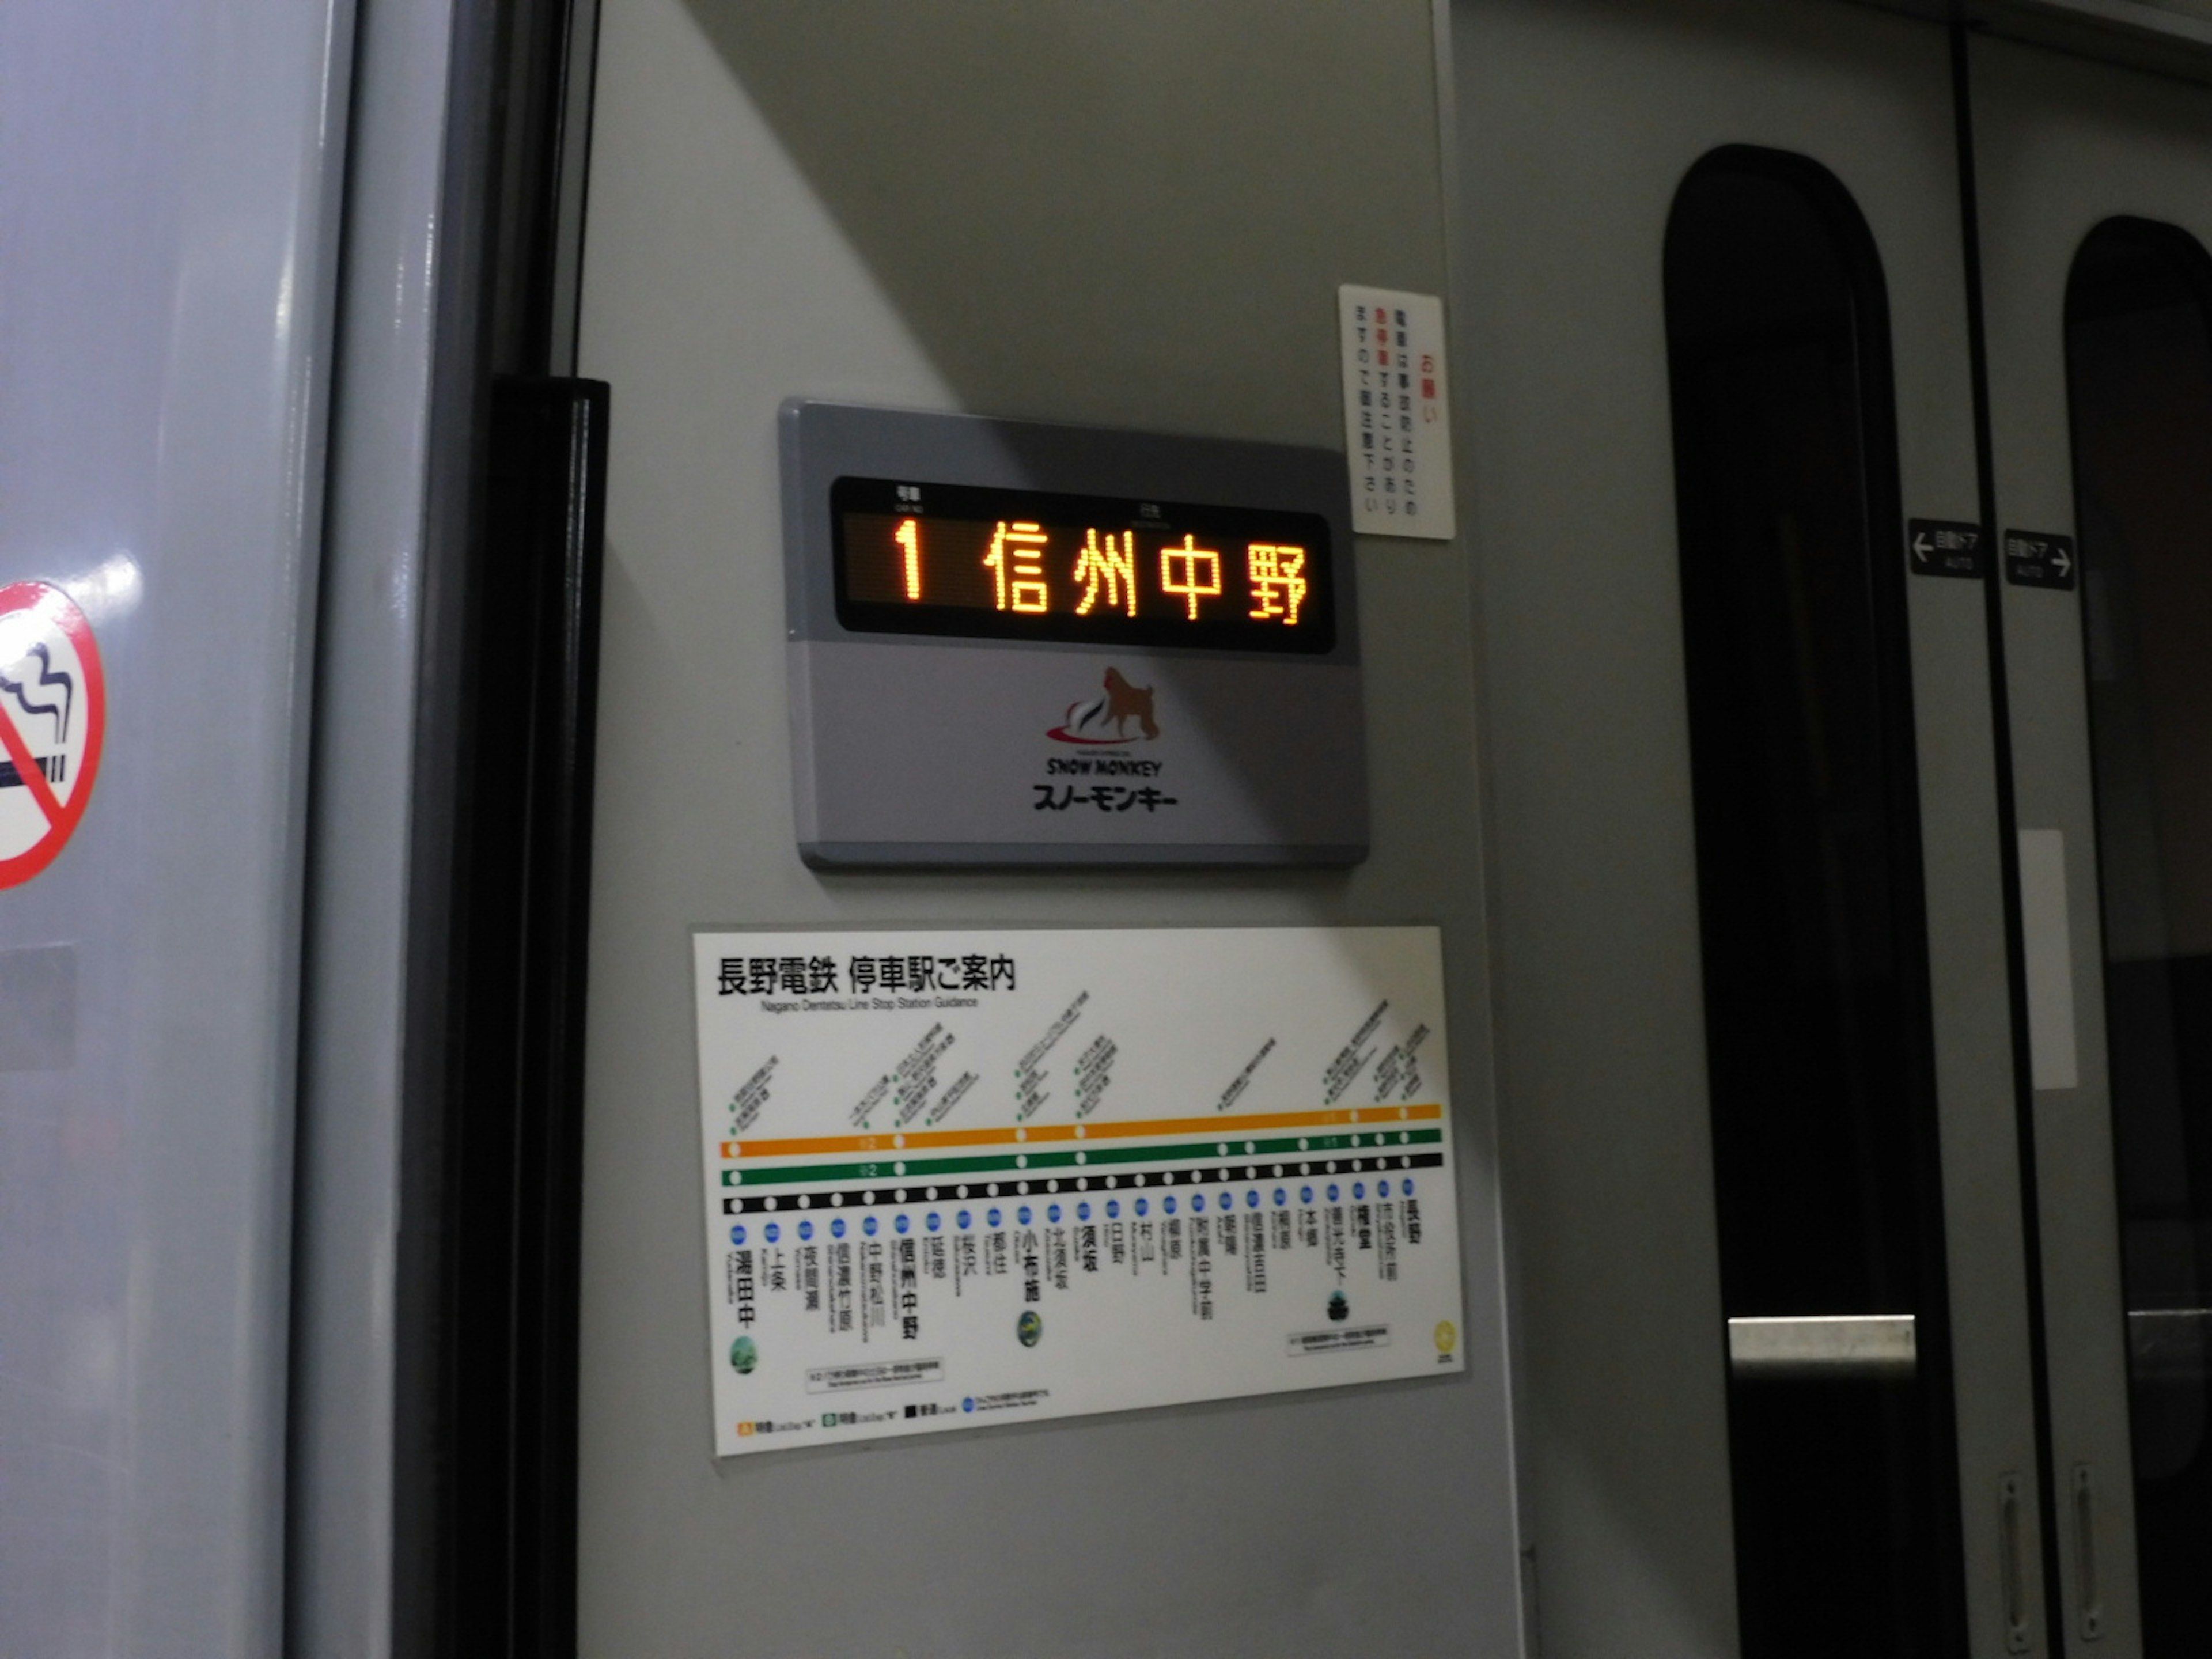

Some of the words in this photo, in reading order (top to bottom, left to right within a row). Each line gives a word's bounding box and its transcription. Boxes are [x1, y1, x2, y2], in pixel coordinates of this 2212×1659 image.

[895, 518, 921, 600] 1
[983, 520, 1307, 625] 信州中野
[1047, 758, 1091, 775] SNOW
[1094, 760, 1162, 777] MONKEY
[1033, 785, 1178, 812] スノーモンキー
[718, 955, 838, 996] 長野電鉄
[849, 953, 1016, 994] 停車駅ご案内
[761, 999, 799, 1014] Nagano
[848, 998, 869, 1010] Line
[872, 997, 895, 1011] Stop
[898, 997, 931, 1009] Station
[934, 996, 978, 1009] Guidance
[736, 1250, 755, 1328] 湯田中
[900, 1238, 918, 1340] 信州中野
